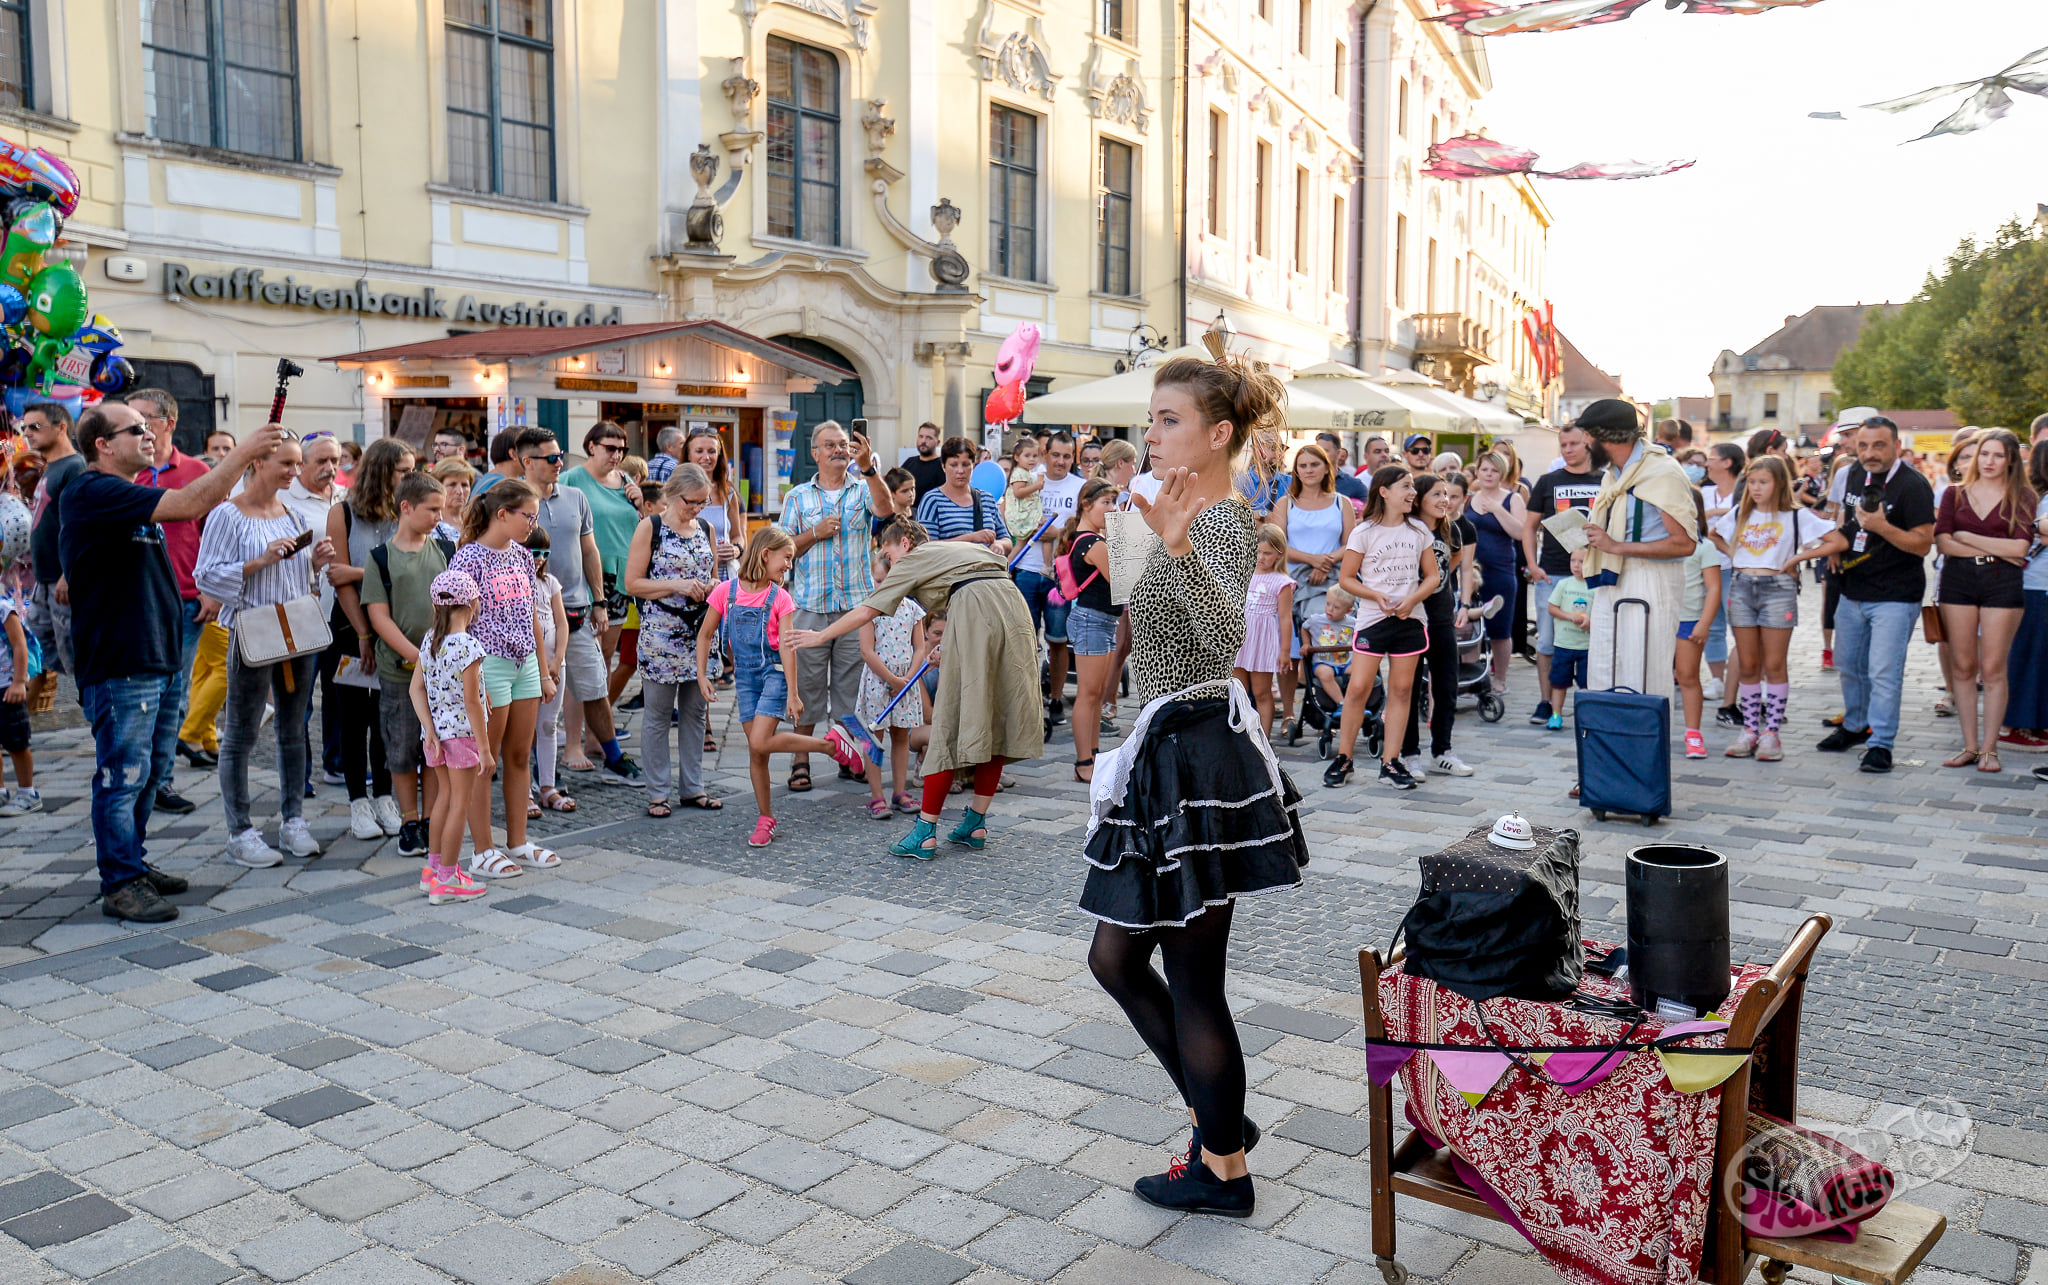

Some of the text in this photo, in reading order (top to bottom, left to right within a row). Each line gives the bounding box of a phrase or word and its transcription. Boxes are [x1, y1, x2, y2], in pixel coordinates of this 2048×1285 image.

[163, 262, 447, 319] Raiffeisenbank
[455, 294, 568, 328] Austria
[60, 355, 89, 377] FAST
